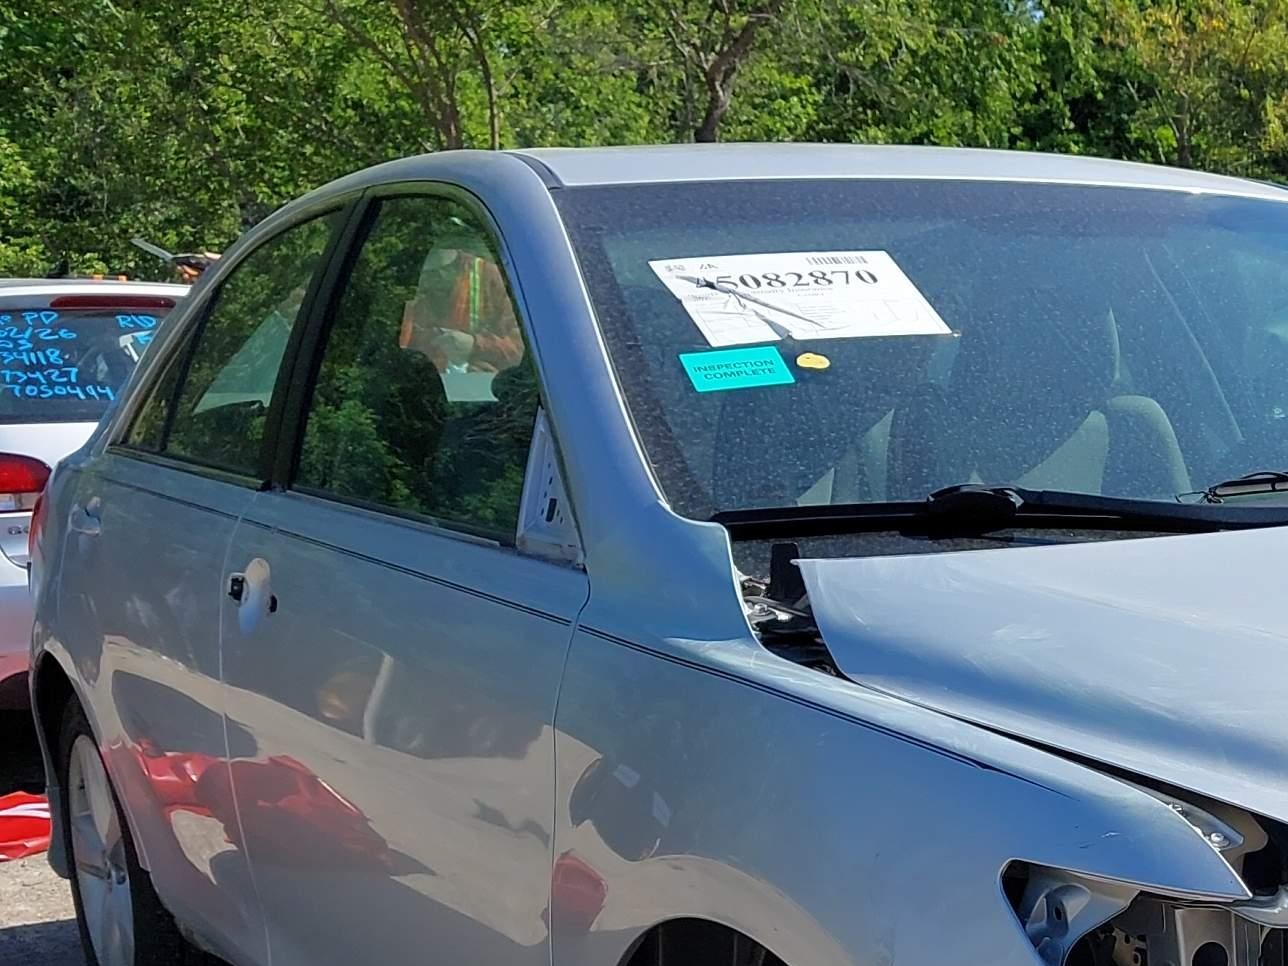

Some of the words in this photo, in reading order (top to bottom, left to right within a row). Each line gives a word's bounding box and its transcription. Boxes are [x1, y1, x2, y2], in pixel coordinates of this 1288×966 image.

[22, 311, 58, 325] PD
[693, 359, 774, 373] INSPECTION
[703, 367, 776, 381] COMPLETE
